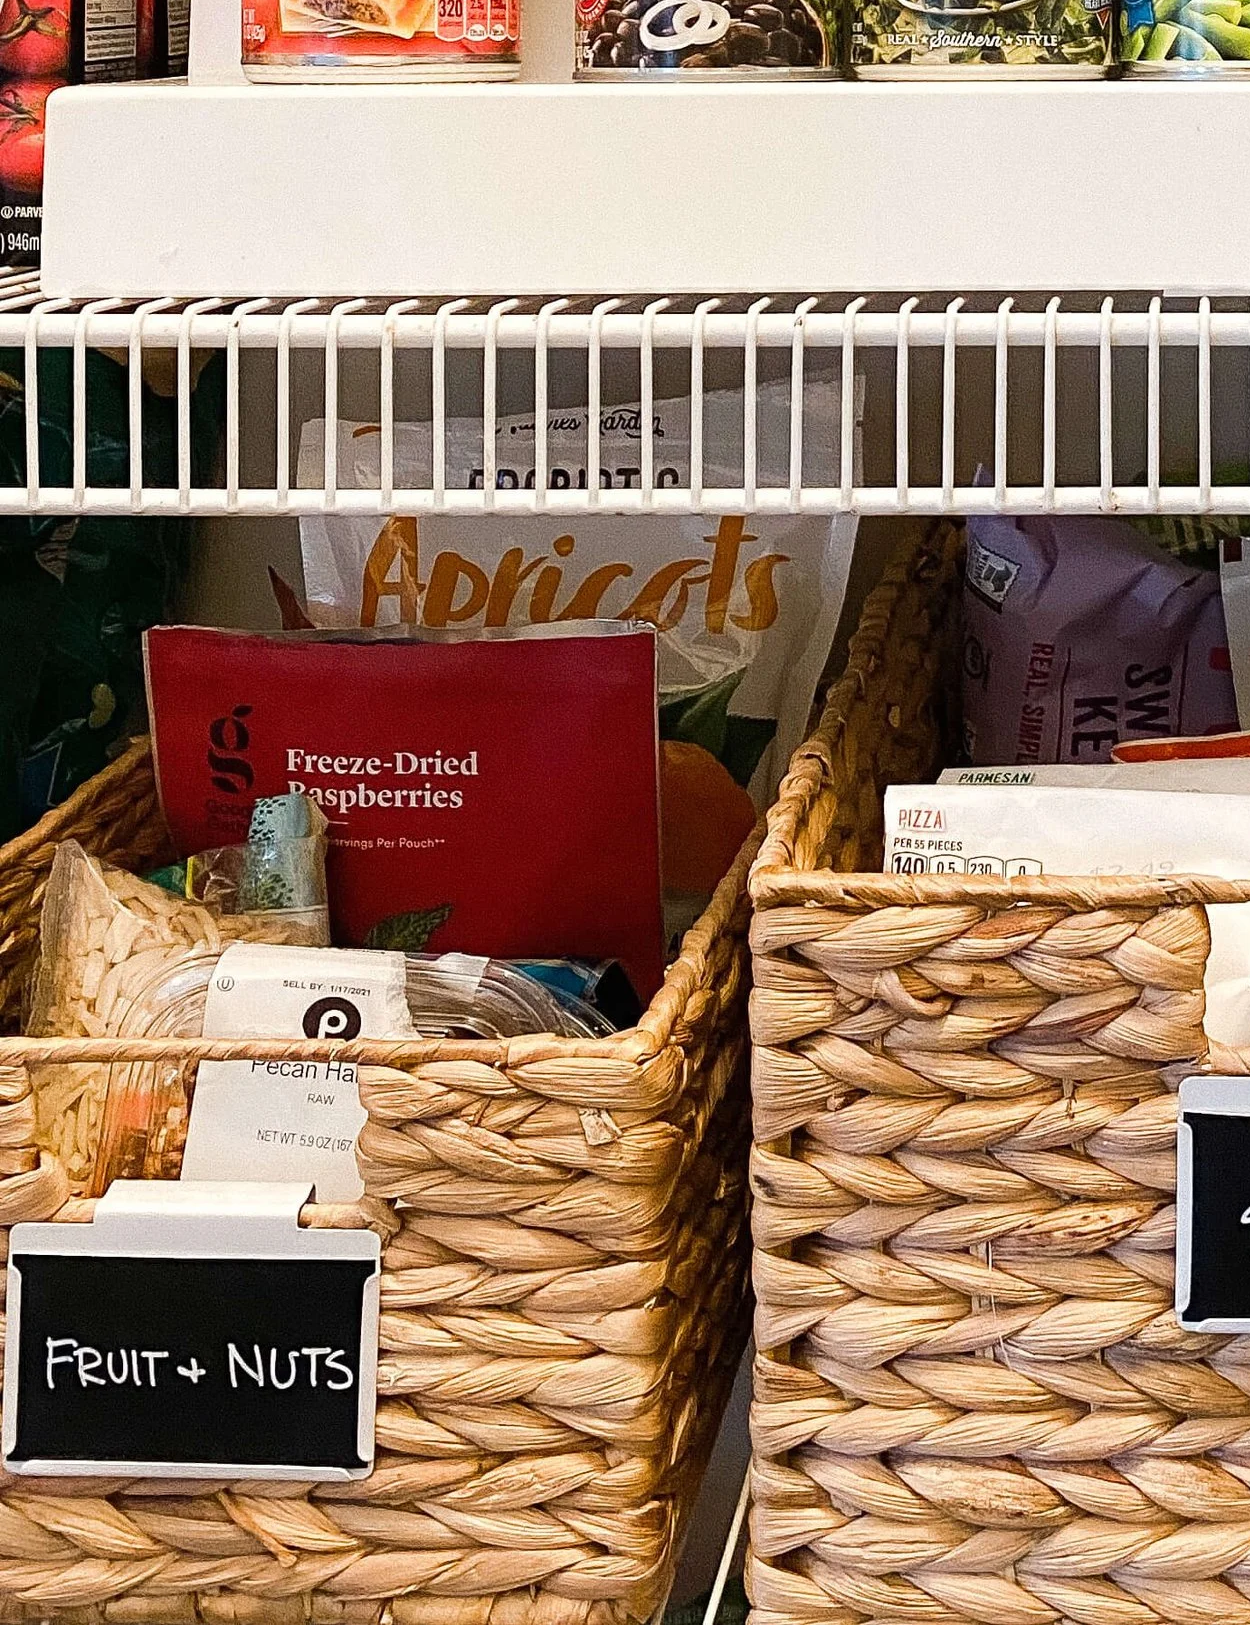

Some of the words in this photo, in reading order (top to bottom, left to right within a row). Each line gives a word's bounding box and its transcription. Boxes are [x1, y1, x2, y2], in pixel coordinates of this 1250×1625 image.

[439, 0, 463, 17] 320
[888, 35, 918, 45] REAL
[929, 30, 1001, 50] Southern
[1016, 35, 1059, 46] STYLE
[360, 515, 791, 635] Apricots
[285, 749, 479, 777] Freeze-Dried
[959, 773, 1032, 785] PARMESAN
[287, 781, 464, 814] Raspberries
[899, 809, 943, 830] PIZZA
[376, 837, 396, 849] Per
[894, 838, 912, 849] PER
[914, 839, 925, 849] 55
[927, 840, 963, 851] PIECES
[283, 980, 306, 989] SELL
[330, 985, 371, 996] 1/17/2021
[307, 1094, 335, 1105] RAW
[257, 1129, 278, 1142] NET
[280, 1132, 296, 1145] WT
[316, 1136, 330, 1149] OZ
[46, 1336, 168, 1390] FRUIT
[176, 1356, 206, 1384] +
[227, 1343, 354, 1391] NUTS
